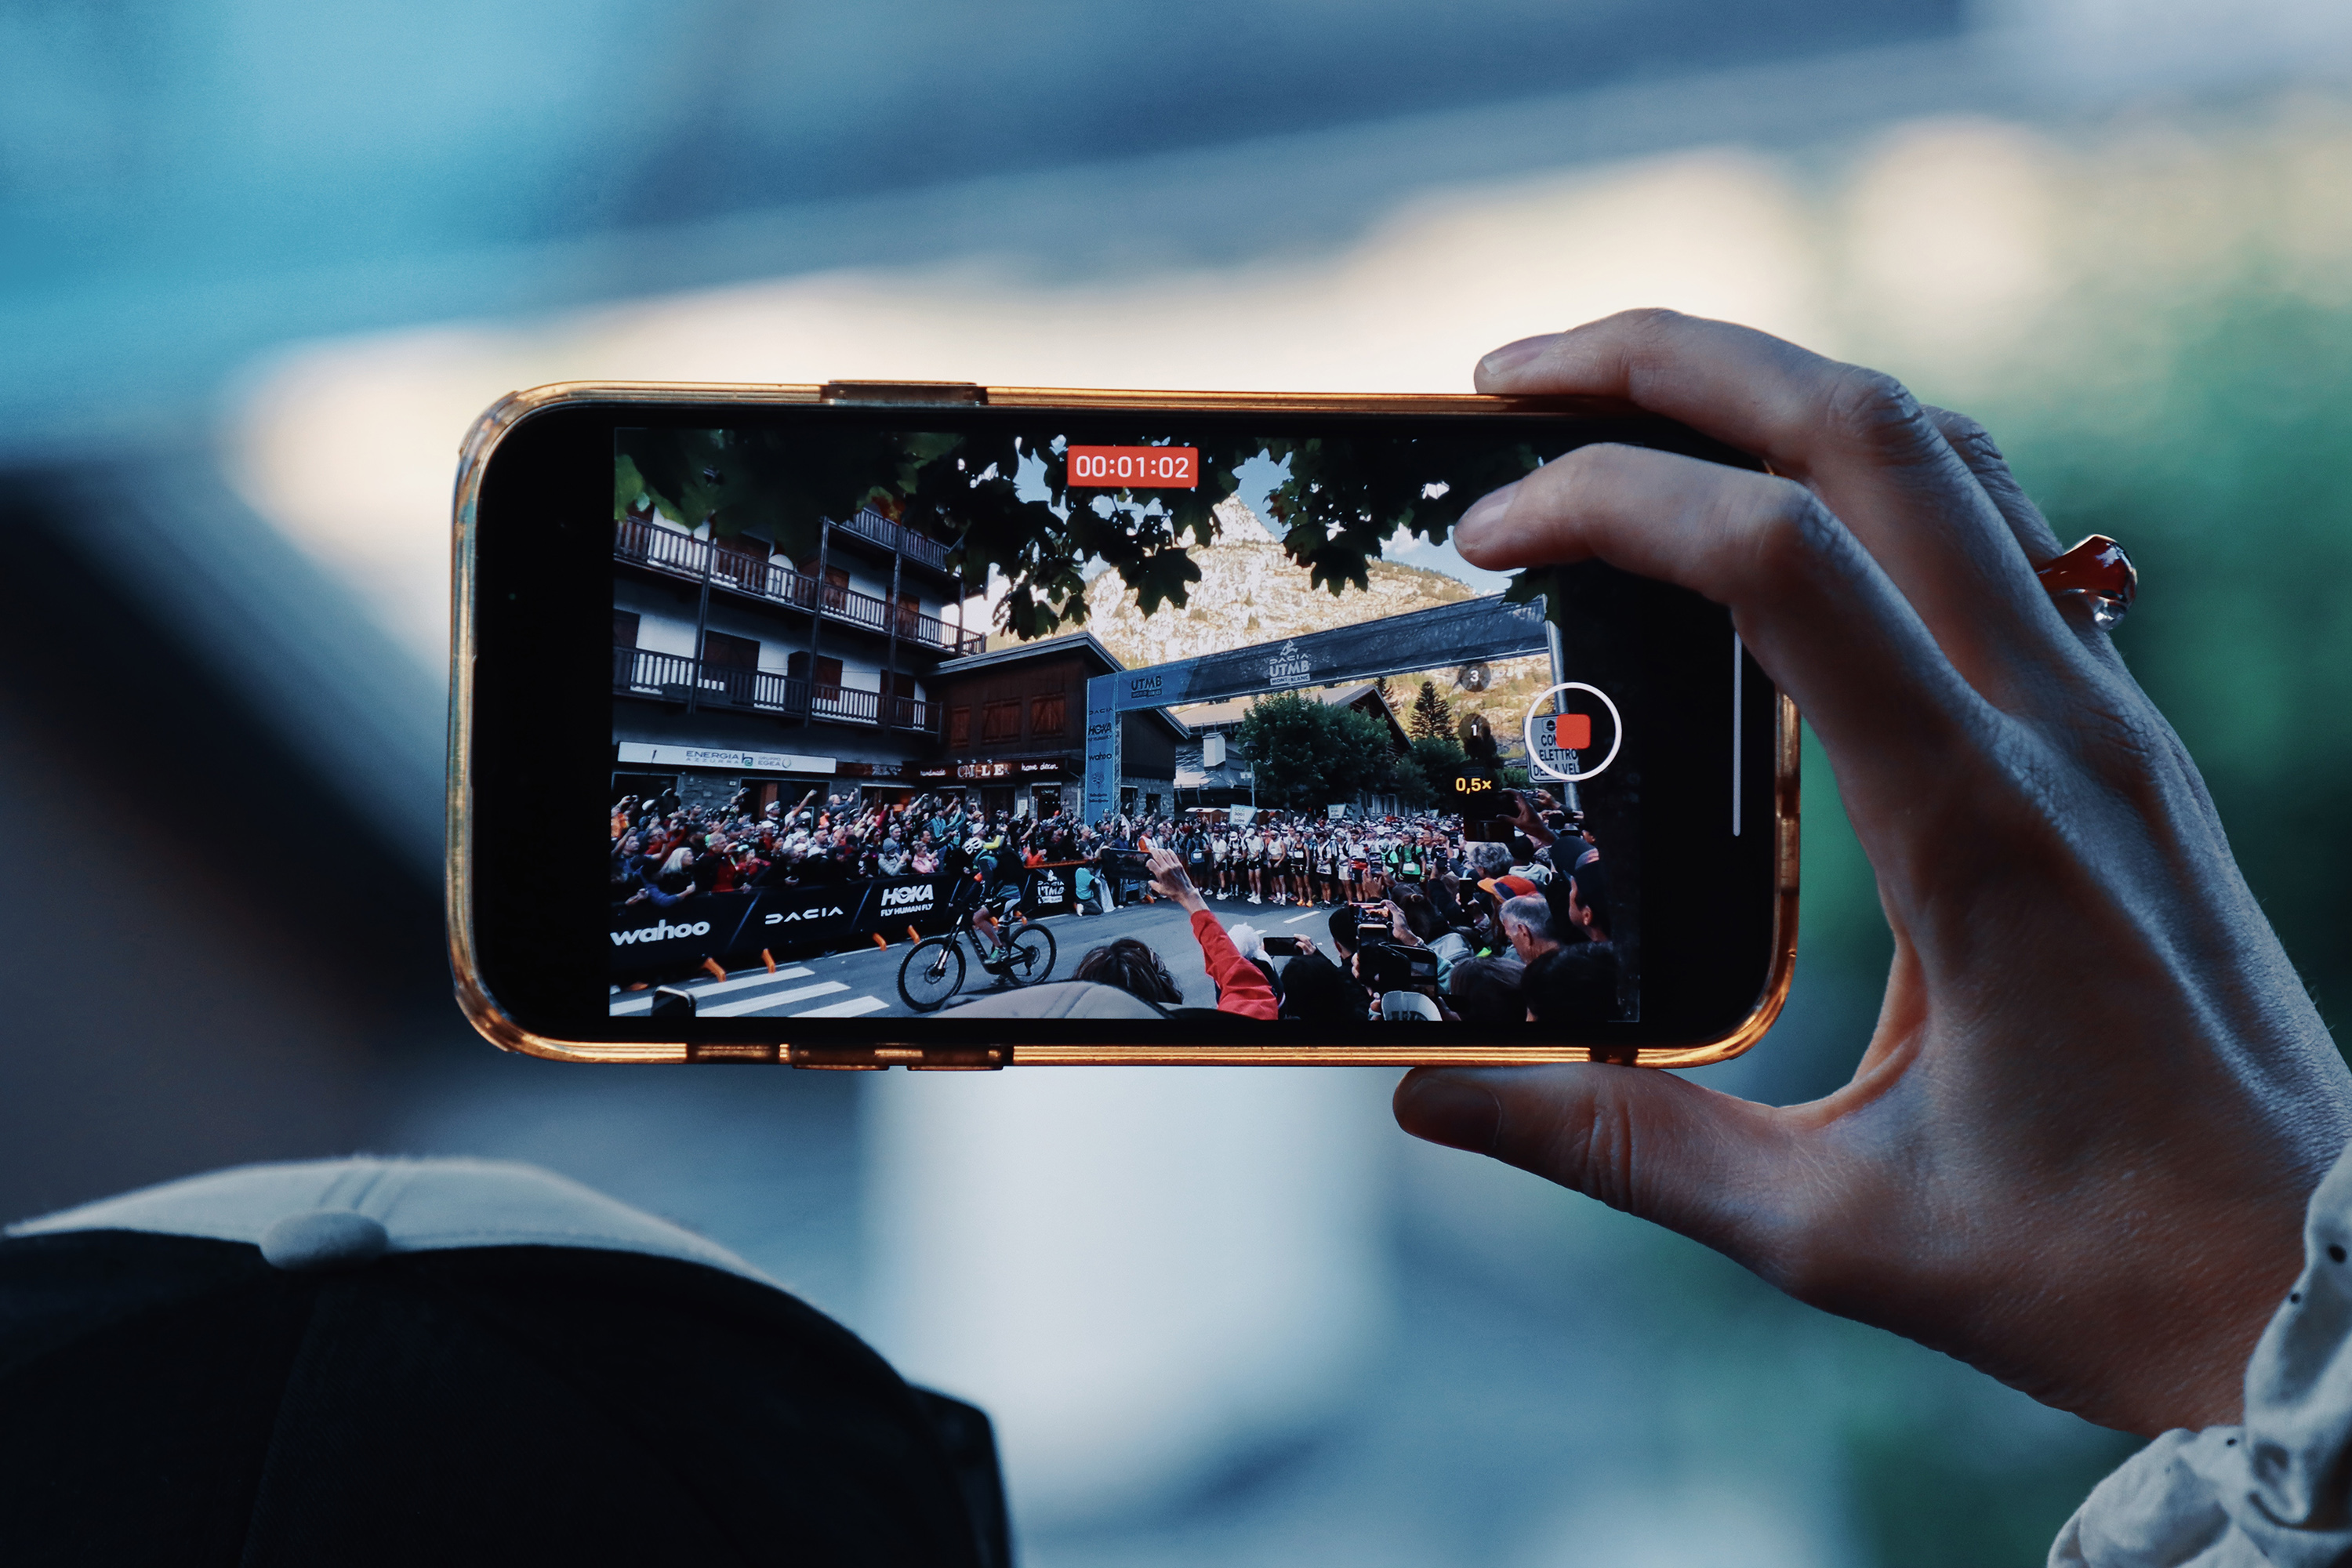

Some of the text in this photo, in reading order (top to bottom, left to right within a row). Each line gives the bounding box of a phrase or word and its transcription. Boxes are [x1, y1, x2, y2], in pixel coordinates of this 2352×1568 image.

[1076, 455, 1189, 478] 00:01:02
[1269, 653, 1308, 665] DACIA
[1269, 660, 1310, 677] UTMB
[1470, 670, 1479, 682] 3
[1131, 676, 1161, 691] UTMB
[1089, 706, 1113, 715] DACIA
[1088, 722, 1112, 735] HOKA
[1471, 724, 1478, 736] 1
[686, 750, 739, 760] ENERGIA
[1021, 763, 1038, 771] home
[880, 884, 934, 906] HOKA
[764, 906, 844, 925] DACIA
[880, 902, 934, 916] FLY HUMAN FLY
[610, 919, 710, 946] wahoo
